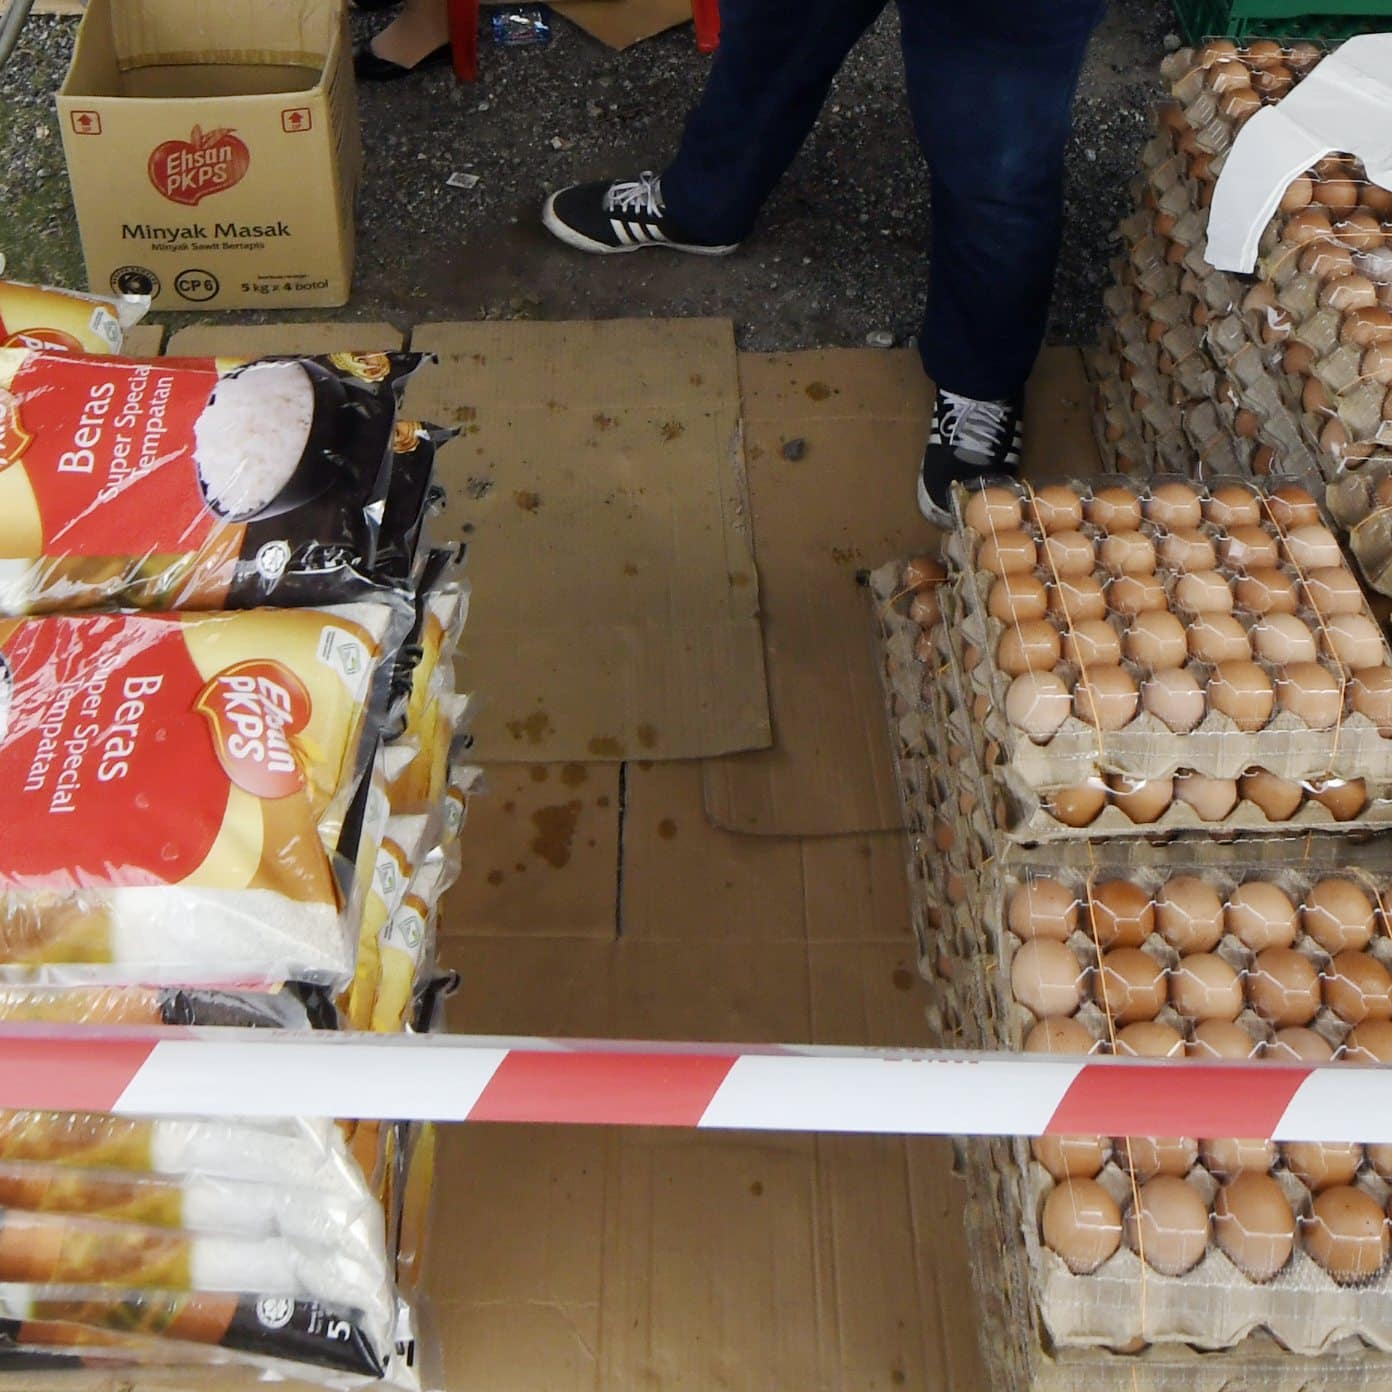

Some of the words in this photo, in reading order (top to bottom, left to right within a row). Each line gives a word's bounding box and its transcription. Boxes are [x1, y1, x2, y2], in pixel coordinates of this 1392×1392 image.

[167, 145, 232, 176] Ehsan
[167, 163, 227, 195] PKPS
[121, 223, 207, 243] Minyak
[214, 221, 291, 239] Masak
[241, 283, 250, 292] 5
[252, 282, 269, 295] kg
[283, 281, 293, 292] 4
[295, 279, 329, 291] botol
[58, 382, 115, 474] Beras
[114, 364, 152, 428] Specia
[130, 376, 175, 481] Tempatan
[98, 434, 132, 504] Super
[23, 680, 80, 792] Tempatan
[97, 674, 164, 783] Beras
[217, 675, 265, 763] PKPS
[257, 677, 297, 774] Ehsan
[49, 725, 100, 814] Special
